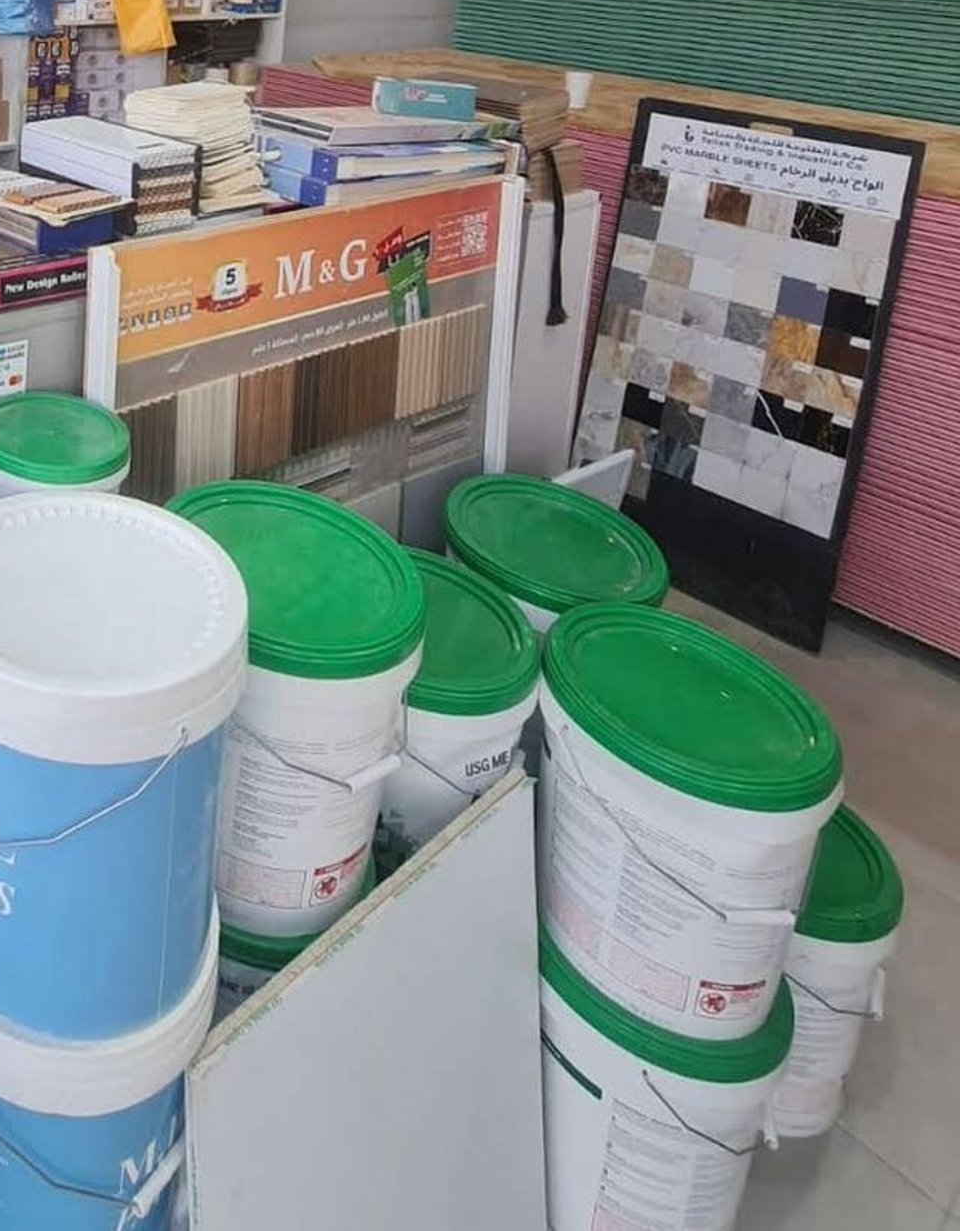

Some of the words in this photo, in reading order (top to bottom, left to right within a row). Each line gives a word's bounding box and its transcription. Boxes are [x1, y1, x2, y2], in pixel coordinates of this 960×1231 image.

[685, 147, 728, 163] MARBLE
[5, 283, 25, 295] New
[27, 275, 58, 289] Design
[225, 268, 236, 285] 5
[465, 756, 490, 777] USG
[491, 750, 509, 768] ME
